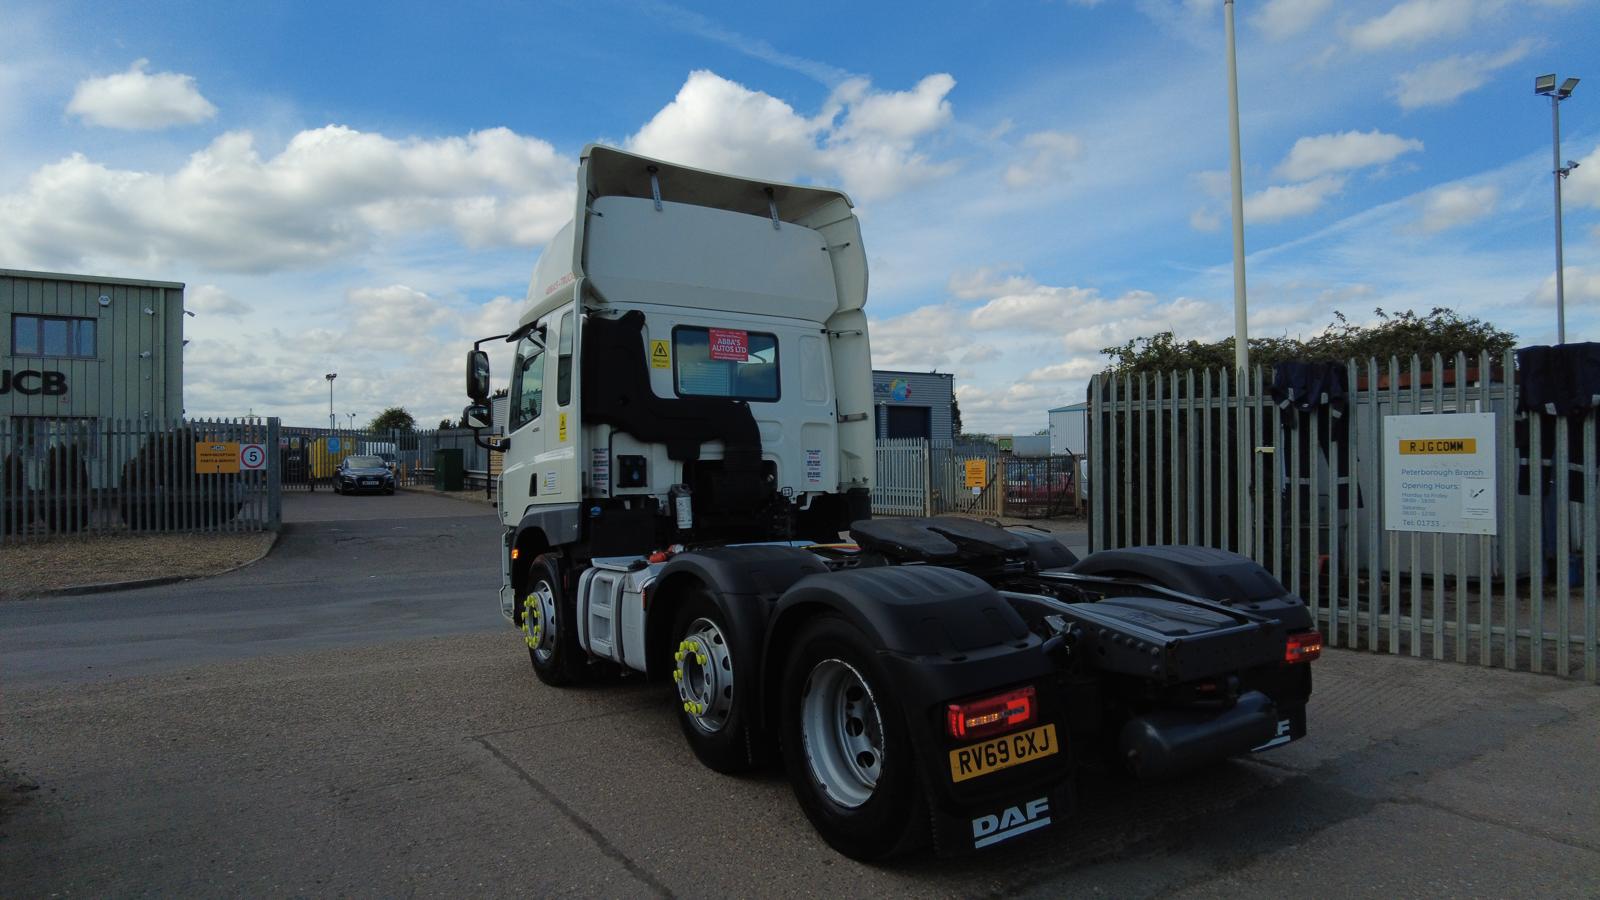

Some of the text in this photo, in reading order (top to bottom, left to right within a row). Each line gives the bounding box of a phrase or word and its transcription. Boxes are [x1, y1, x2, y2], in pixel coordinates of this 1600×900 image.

[717, 338, 741, 346] ABBA'S
[712, 344, 734, 352] AUTOS
[0, 369, 68, 395] JCB
[249, 451, 258, 462] 5
[1401, 469, 1453, 477] Peterborough
[1402, 482, 1432, 490] Opening
[959, 728, 1050, 775] RV69 GXJ
[972, 797, 1048, 838] DAF
